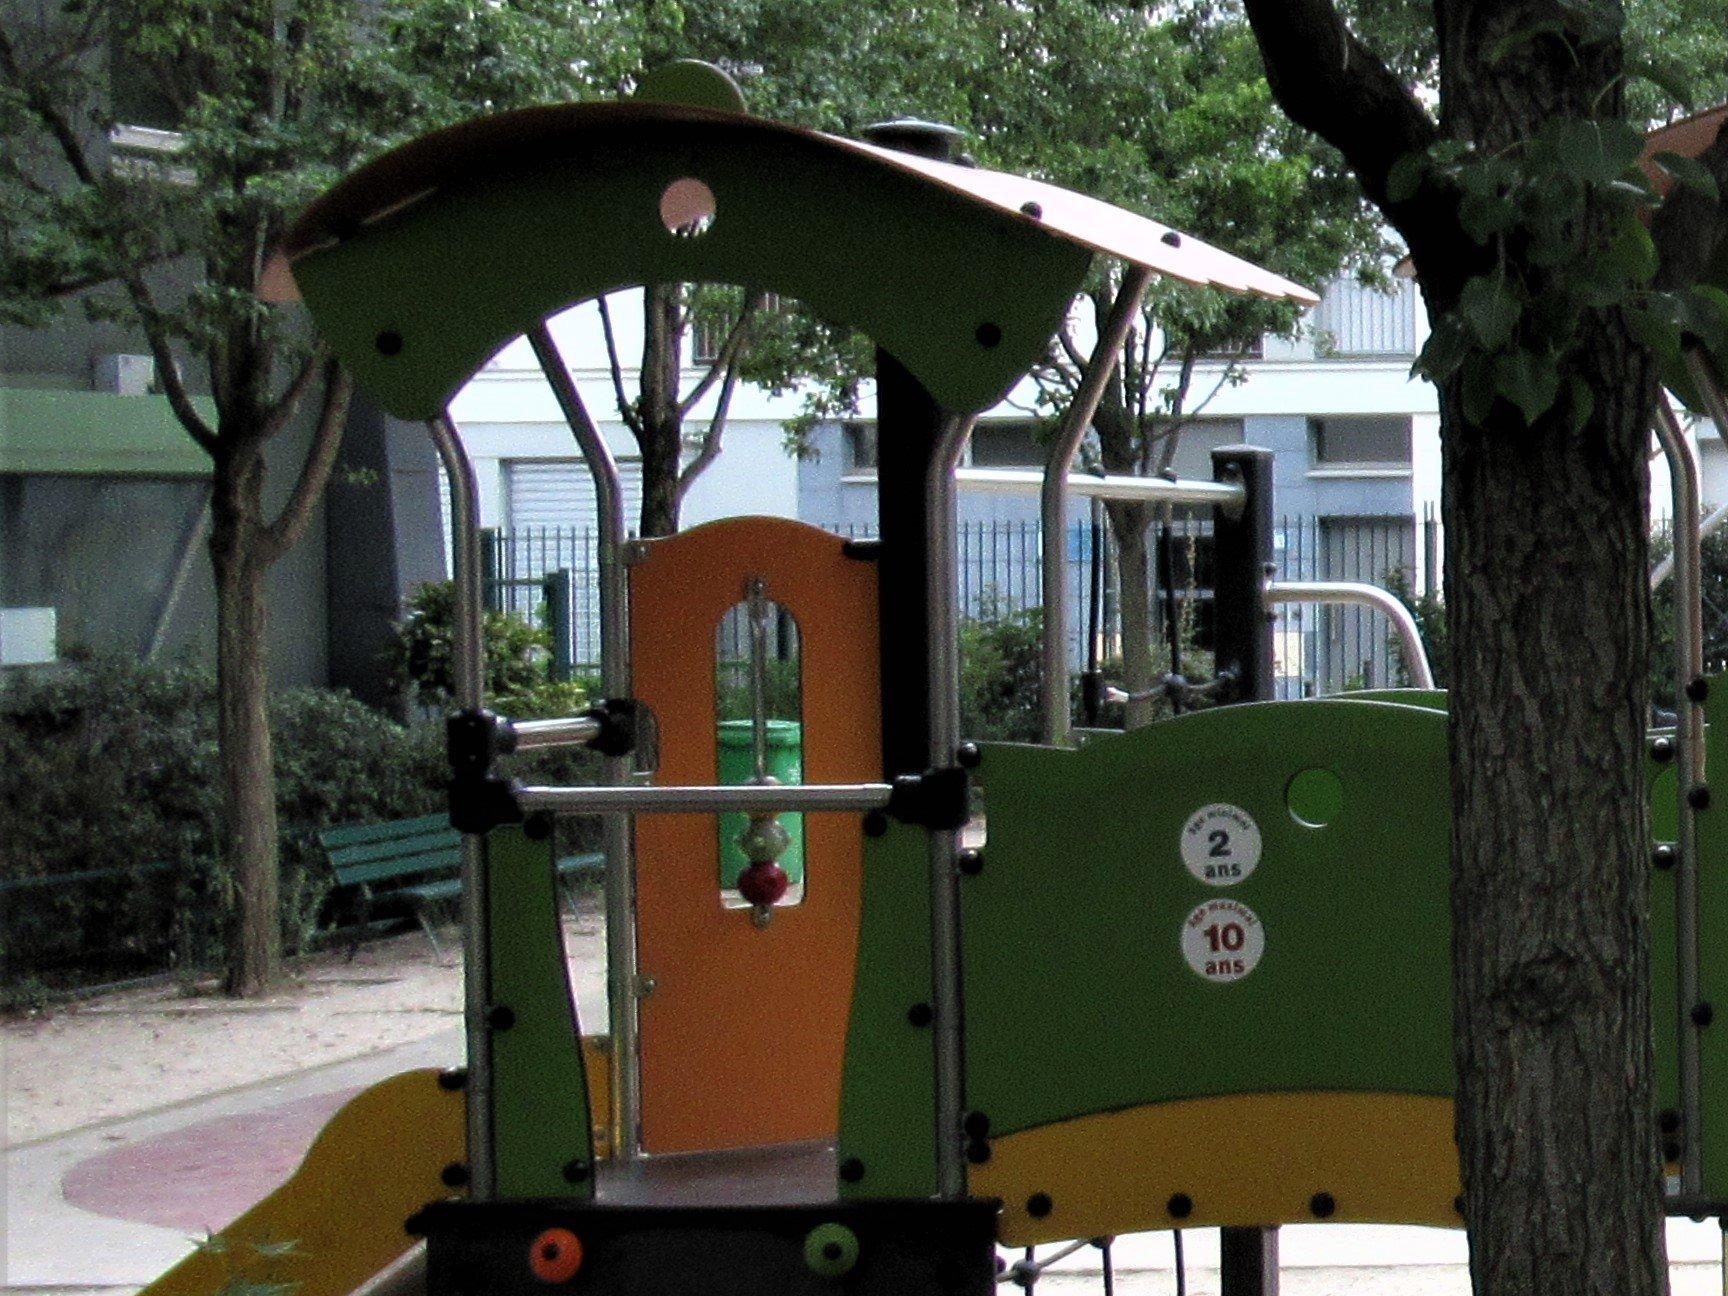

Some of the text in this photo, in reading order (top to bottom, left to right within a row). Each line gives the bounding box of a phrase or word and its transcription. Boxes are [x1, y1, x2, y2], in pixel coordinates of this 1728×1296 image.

[1207, 829, 1232, 857] 2
[1204, 862, 1242, 880] ans
[1203, 921, 1245, 952] 10
[1205, 958, 1245, 975] ans
